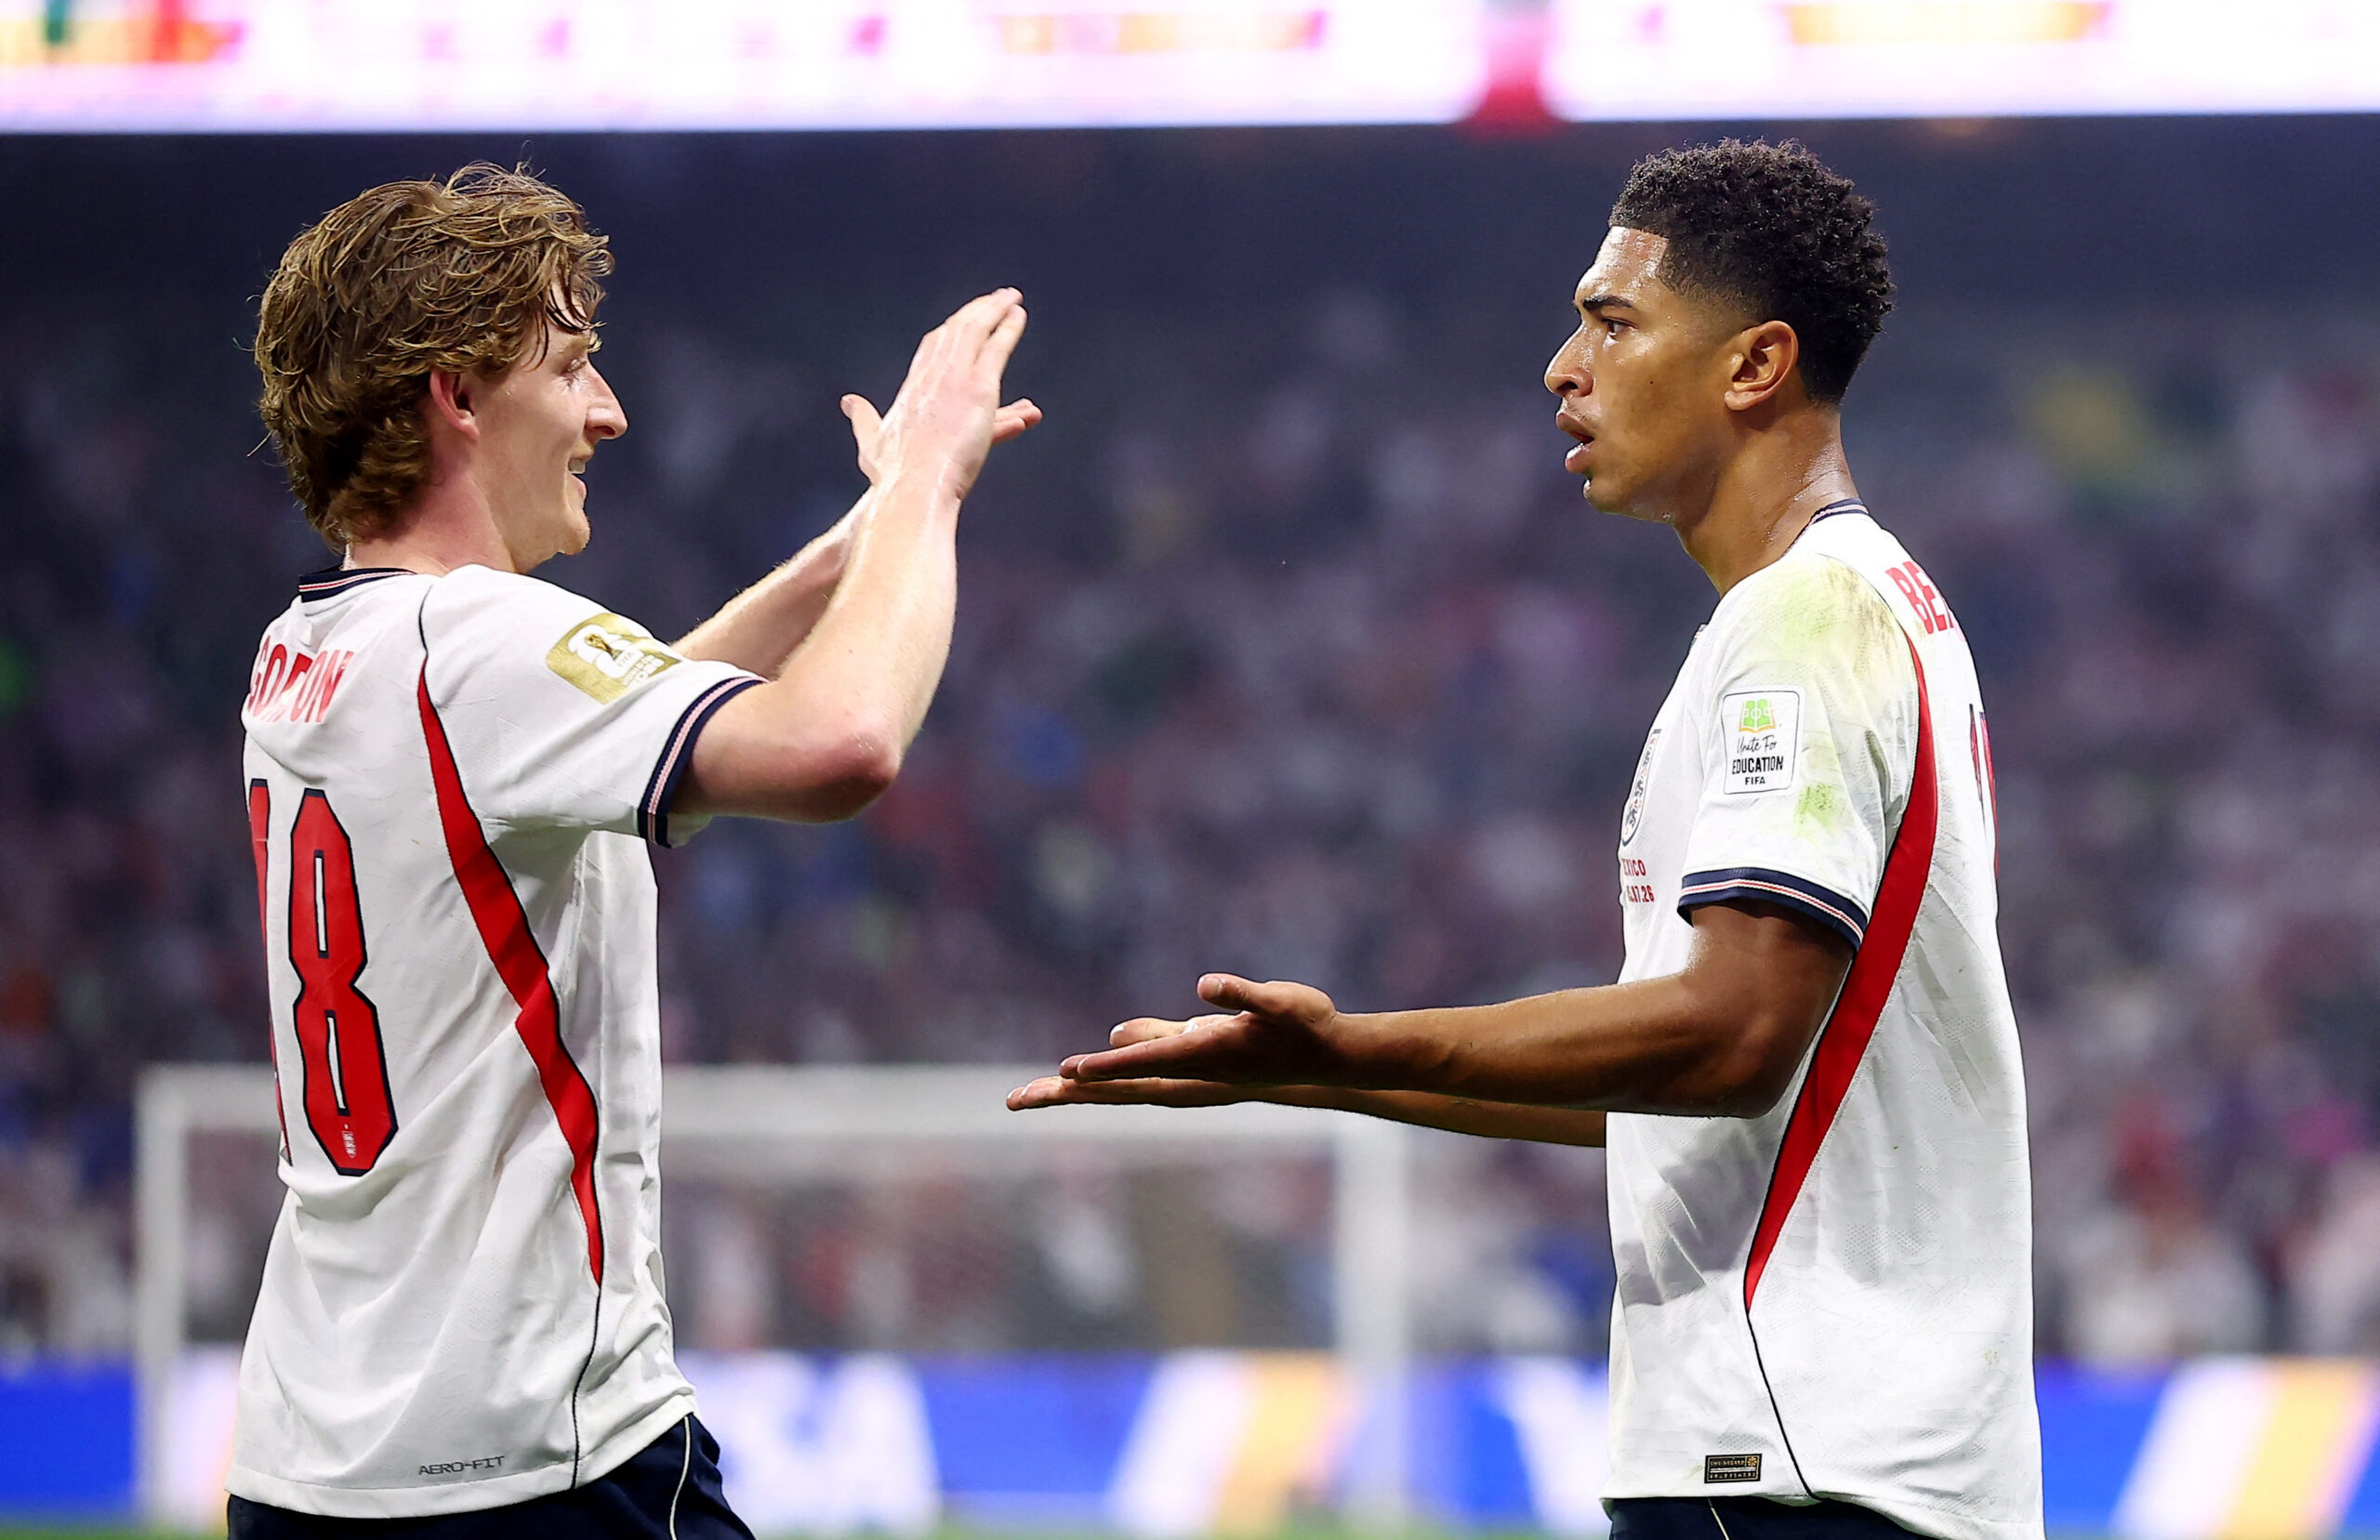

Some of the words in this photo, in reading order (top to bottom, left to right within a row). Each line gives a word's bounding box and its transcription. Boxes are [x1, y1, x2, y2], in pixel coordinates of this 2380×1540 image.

[245, 635, 354, 723] GOON
[1737, 736, 1760, 755] Unite
[1763, 734, 1778, 752] For
[1731, 756, 1784, 775] EDUCATION
[1744, 776, 1766, 785] FIFA
[1621, 858, 1646, 876] EXICO
[248, 778, 399, 1178] 18
[418, 1455, 505, 1475] AERO-FIT
